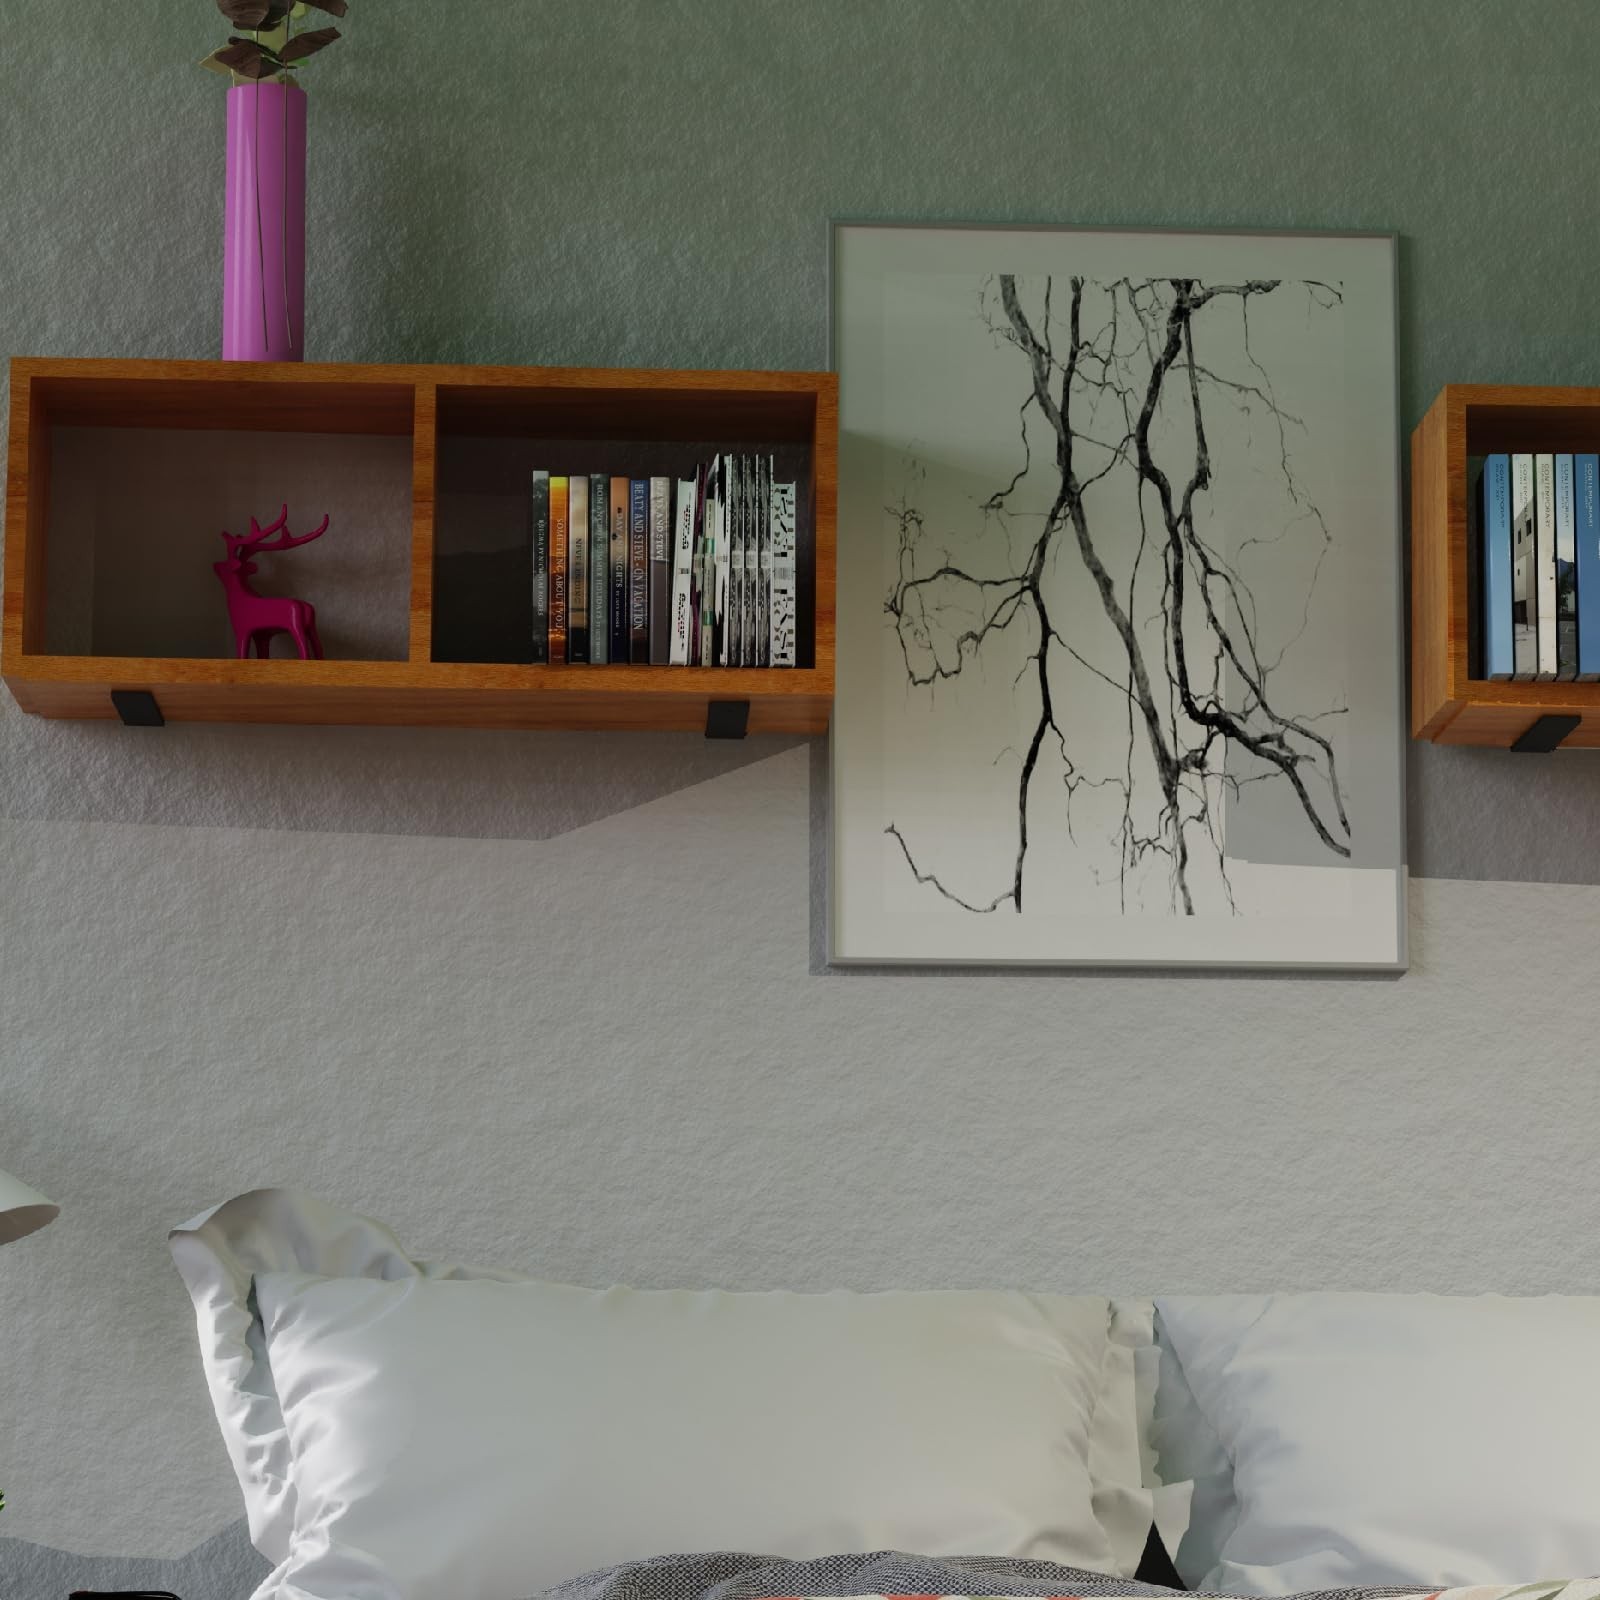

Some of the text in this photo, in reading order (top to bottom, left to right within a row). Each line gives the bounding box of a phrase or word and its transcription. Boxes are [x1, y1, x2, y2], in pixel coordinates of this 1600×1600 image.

[634, 483, 644, 511] BEATY
[616, 512, 624, 531] DAY
[633, 513, 644, 533] AND
[656, 511, 664, 532] AND
[633, 534, 644, 561] STEVE
[656, 533, 664, 561] STEVE
[555, 518, 564, 629] SOMETHING ABOUT YOU
[615, 555, 624, 588] NIGHTS
[633, 568, 643, 581] ON
[633, 584, 644, 630] VACATION
